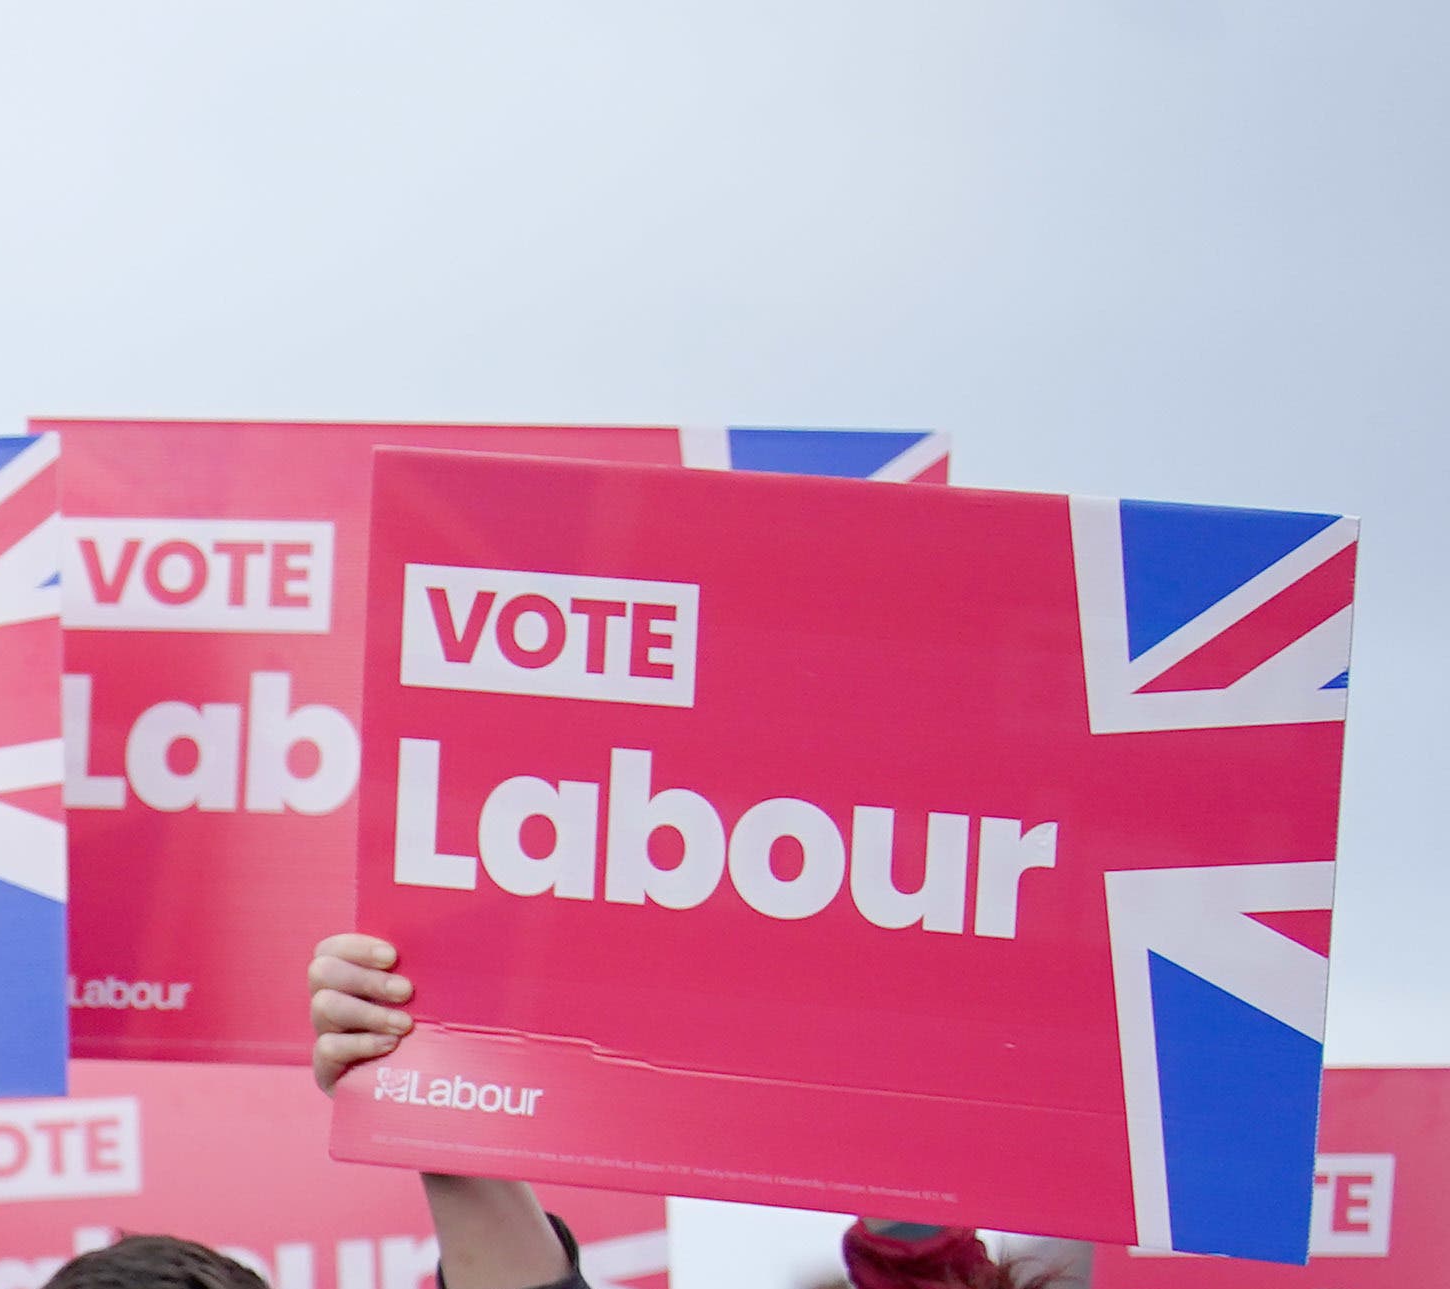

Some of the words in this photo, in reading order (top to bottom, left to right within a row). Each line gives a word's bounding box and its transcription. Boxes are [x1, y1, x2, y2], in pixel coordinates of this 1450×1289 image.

[79, 537, 312, 609] VOTE
[426, 586, 678, 680] VOTE
[393, 737, 1059, 941] Labour
[409, 1069, 544, 1117] Labour
